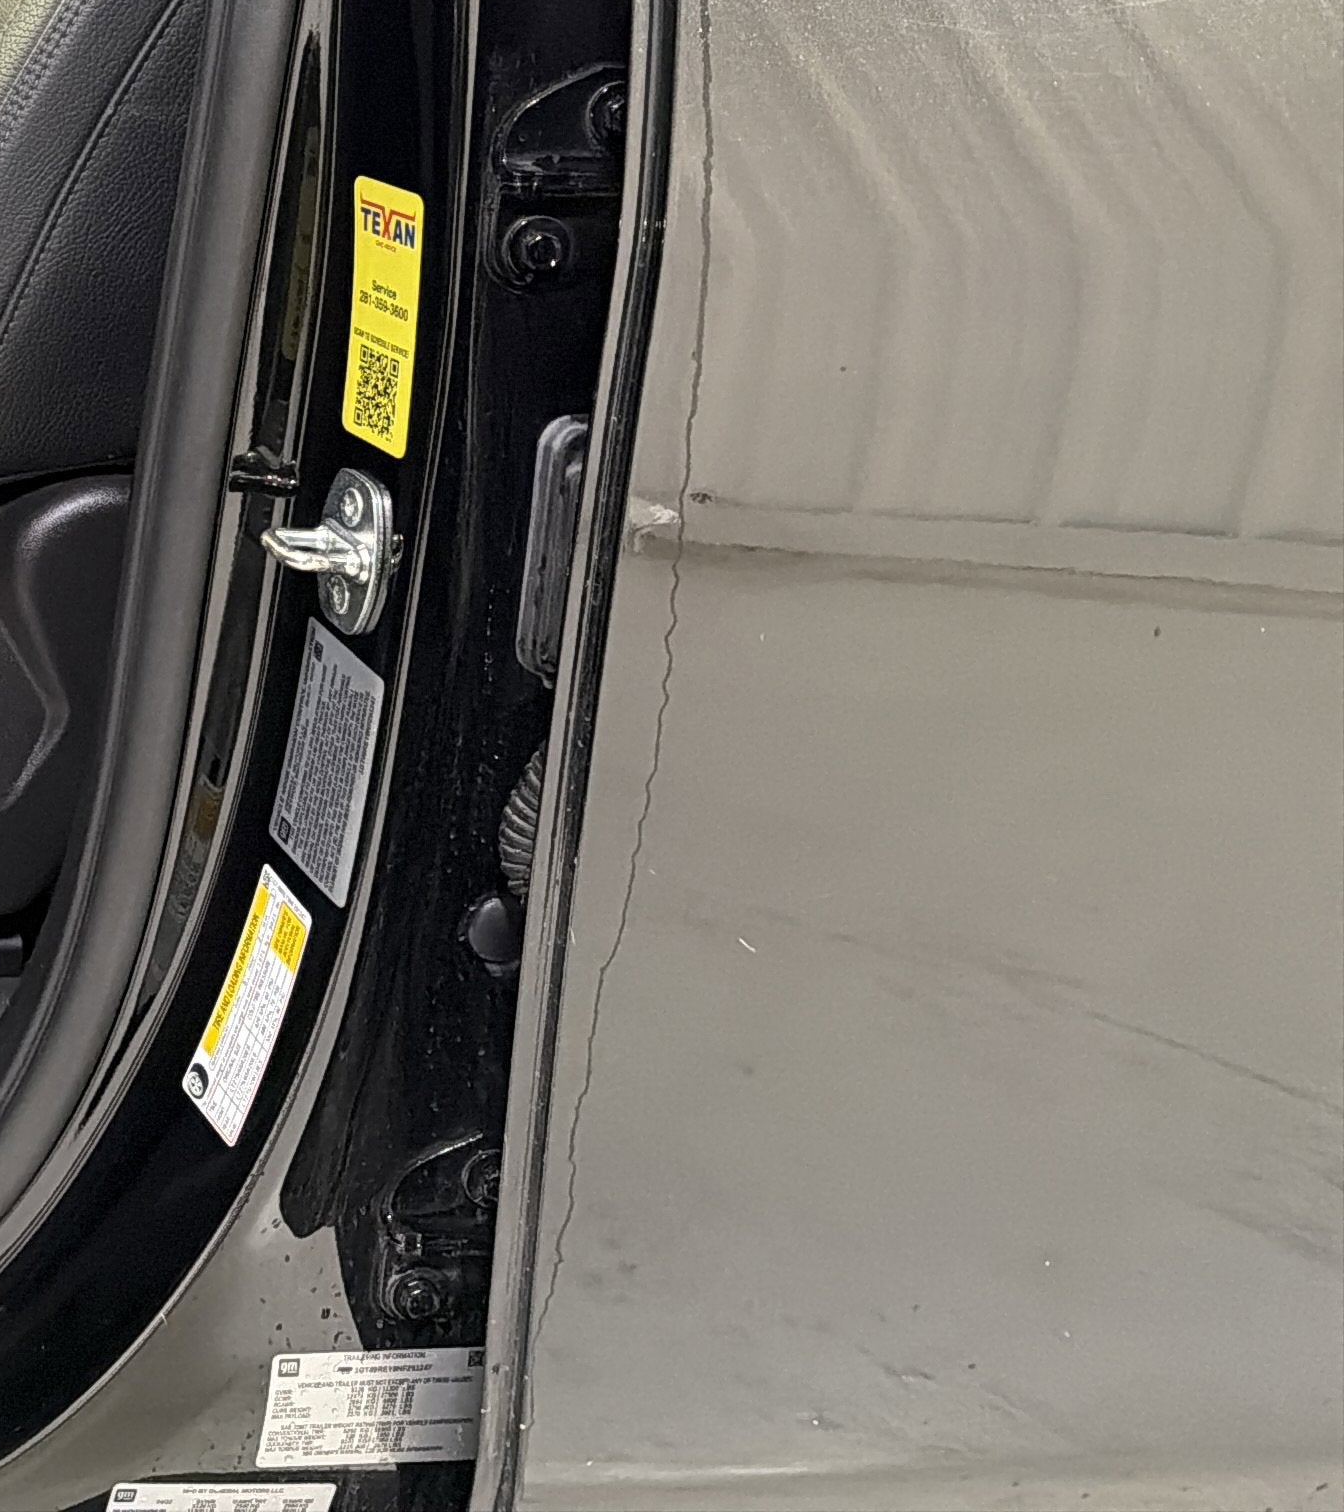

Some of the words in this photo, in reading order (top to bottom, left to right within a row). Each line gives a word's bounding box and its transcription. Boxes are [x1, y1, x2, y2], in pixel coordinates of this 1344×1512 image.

[359, 197, 416, 249] TEXAN
[372, 280, 396, 300] Service
[280, 1361, 298, 1375] gm
[117, 1491, 135, 1501] gm
